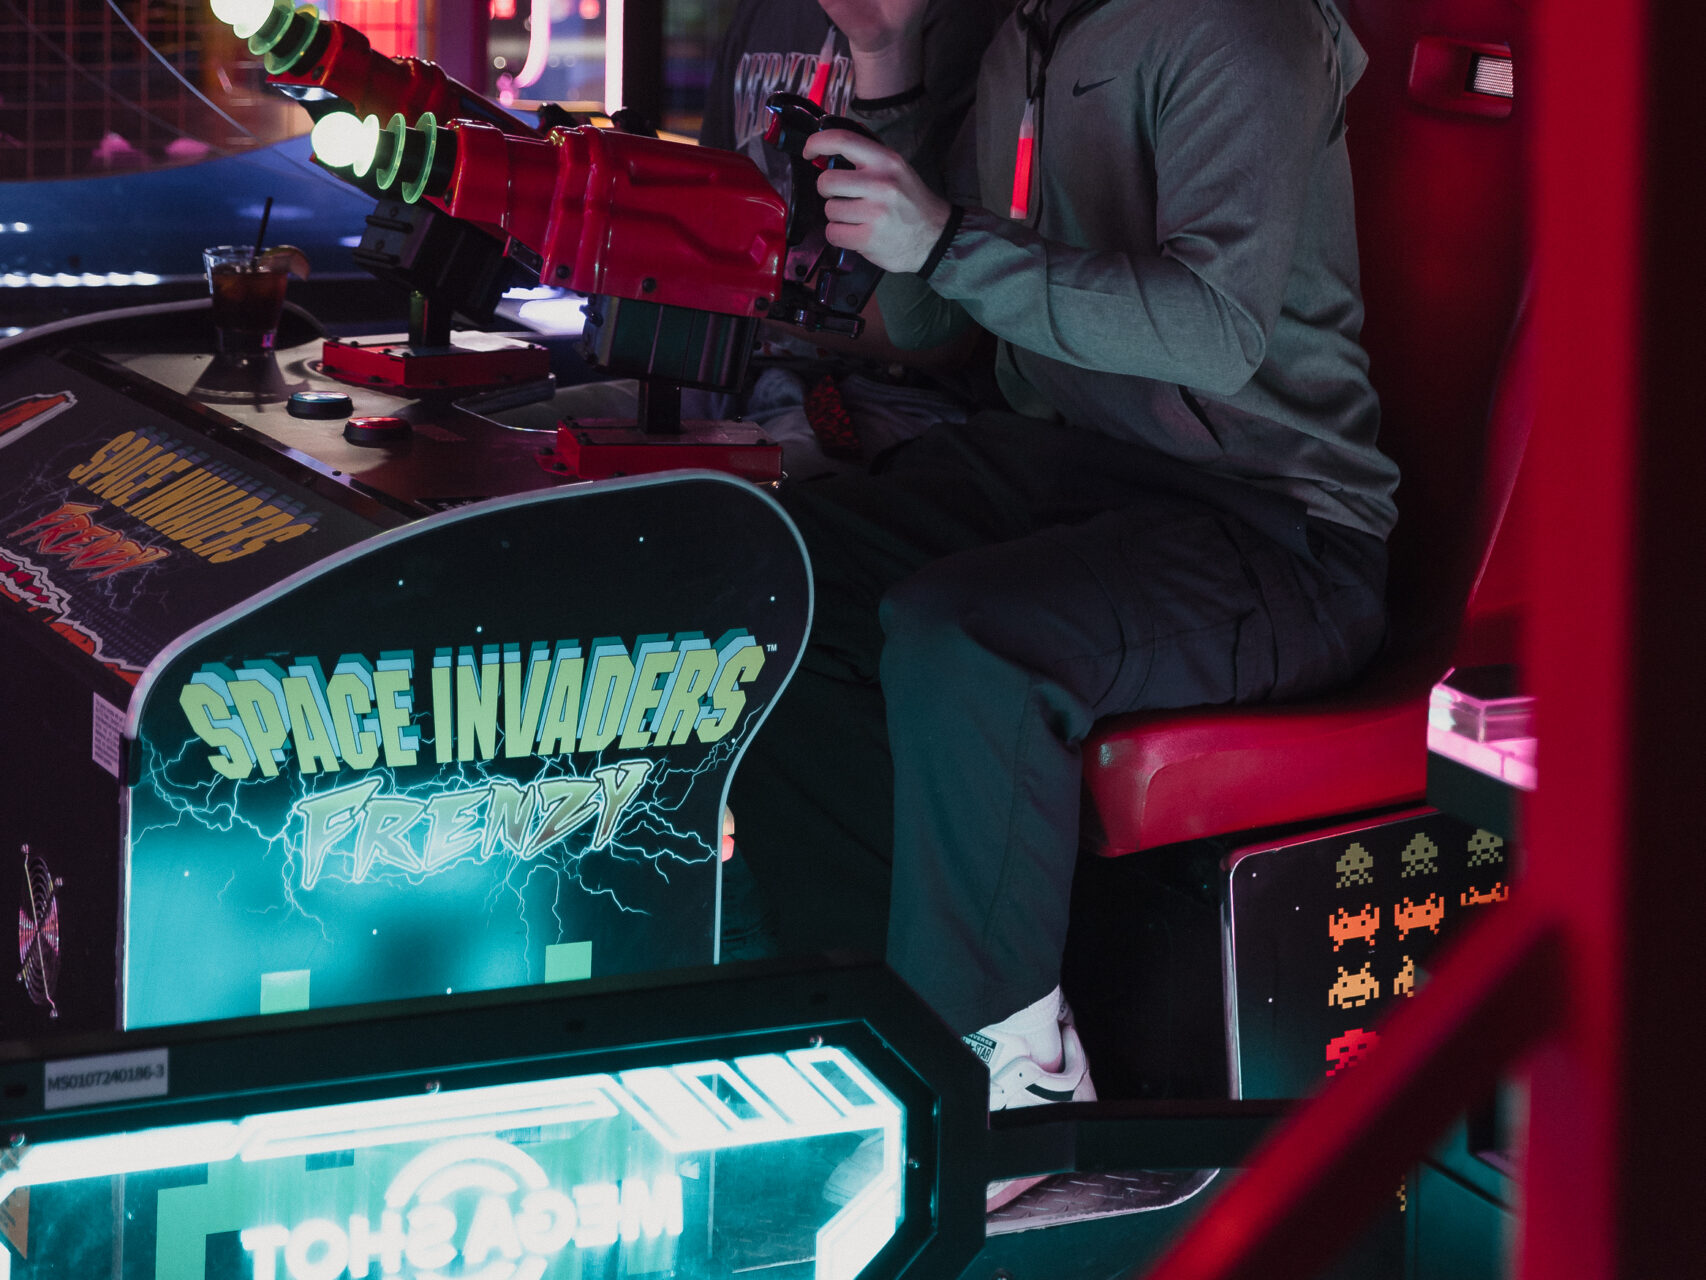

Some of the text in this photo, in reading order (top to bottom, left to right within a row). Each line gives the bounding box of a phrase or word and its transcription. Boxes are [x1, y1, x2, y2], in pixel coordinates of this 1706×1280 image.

[6, 501, 172, 582] FRENZY
[68, 429, 313, 565] SPACE INVADERS
[179, 662, 420, 780] SPACE
[431, 636, 766, 764] INVADERS
[297, 760, 653, 890] FRENZY
